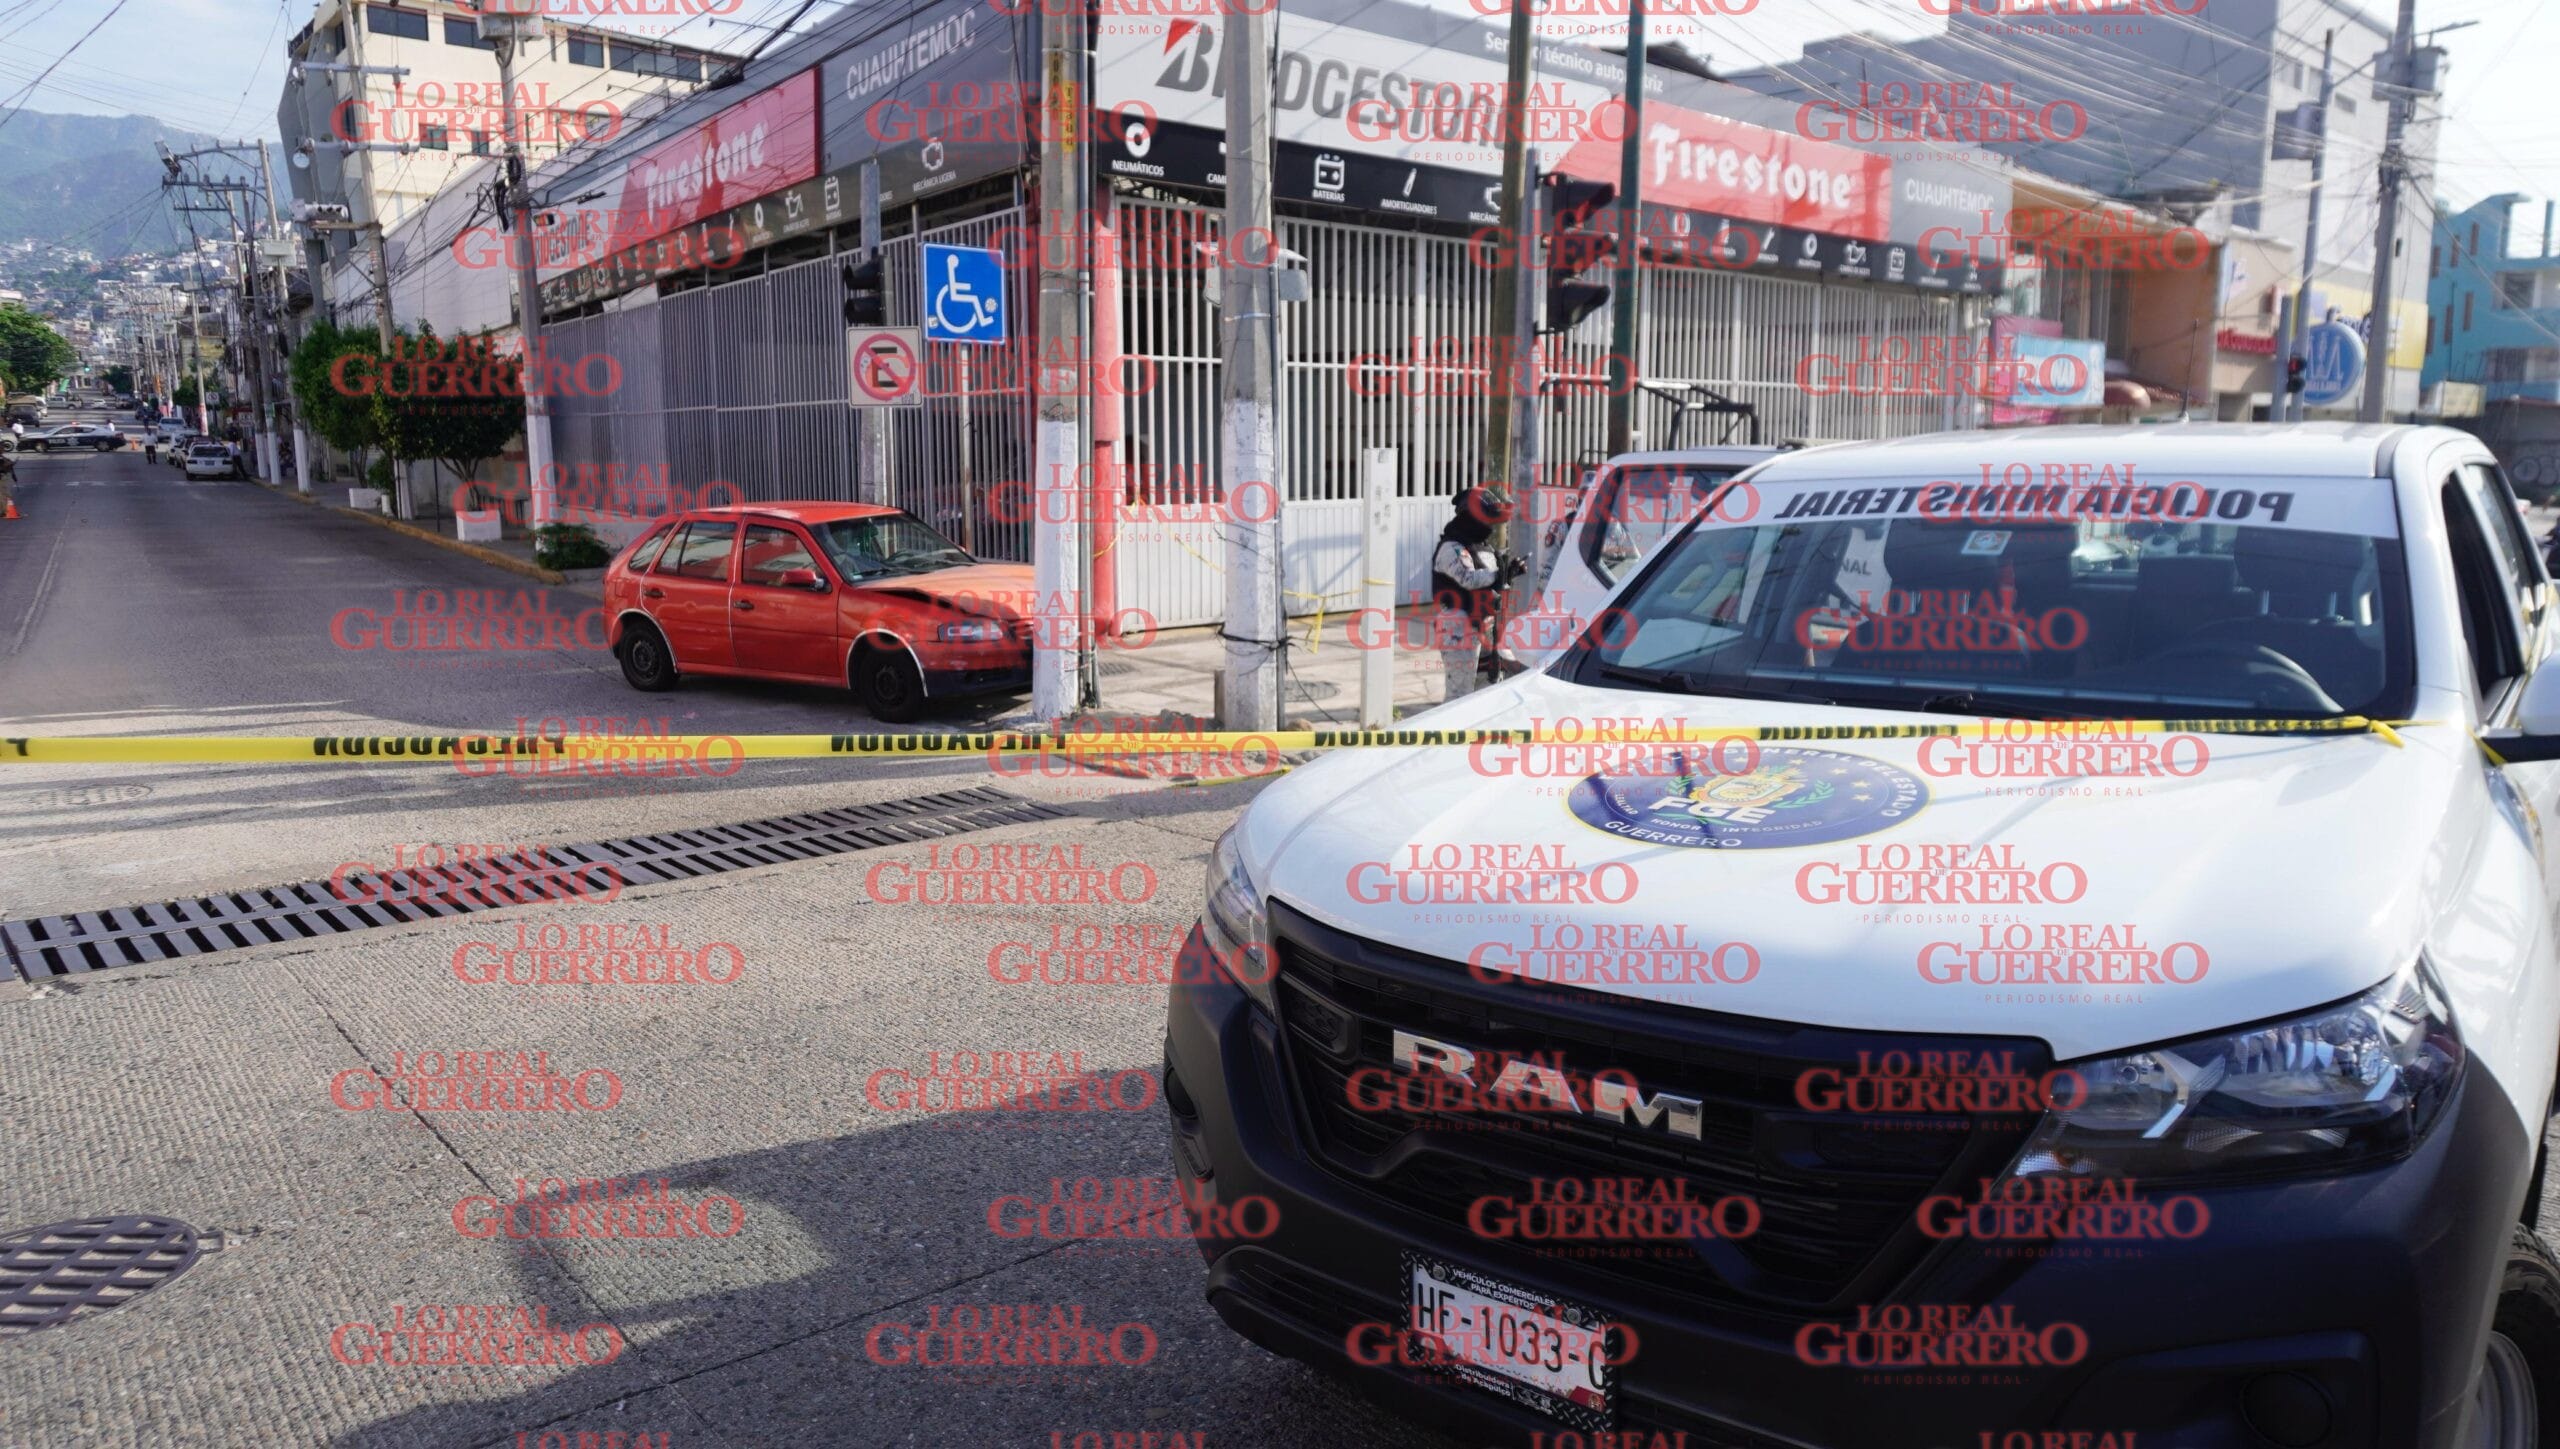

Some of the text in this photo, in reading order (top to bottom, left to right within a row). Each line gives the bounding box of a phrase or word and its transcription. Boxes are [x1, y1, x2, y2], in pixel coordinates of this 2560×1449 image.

[1545, 48, 1594, 76] técnico
[1595, 63, 1664, 94] autotriz
[645, 121, 768, 224] Firestone
[1111, 159, 1165, 178] NEUMÁTICOS
[1648, 122, 1853, 210] Firestone
[1312, 188, 1345, 203] BATERÍAS
[1380, 198, 1438, 215] AMORTIGUADORES
[1469, 210, 1501, 225] MECÁNIC
[1648, 796, 1776, 825] FGE
[1881, 775, 1918, 818] ESTADO
[1604, 820, 1742, 848] GUERRERO
[1650, 817, 1702, 831] HONOR
[1722, 819, 1824, 834] INTEGRIDAD
[1393, 1028, 1703, 1141] RAM
[1452, 1268, 1556, 1307] VEHÍCULOS COMERCIALES
[1470, 1283, 1535, 1309] PARA EXPERTOS
